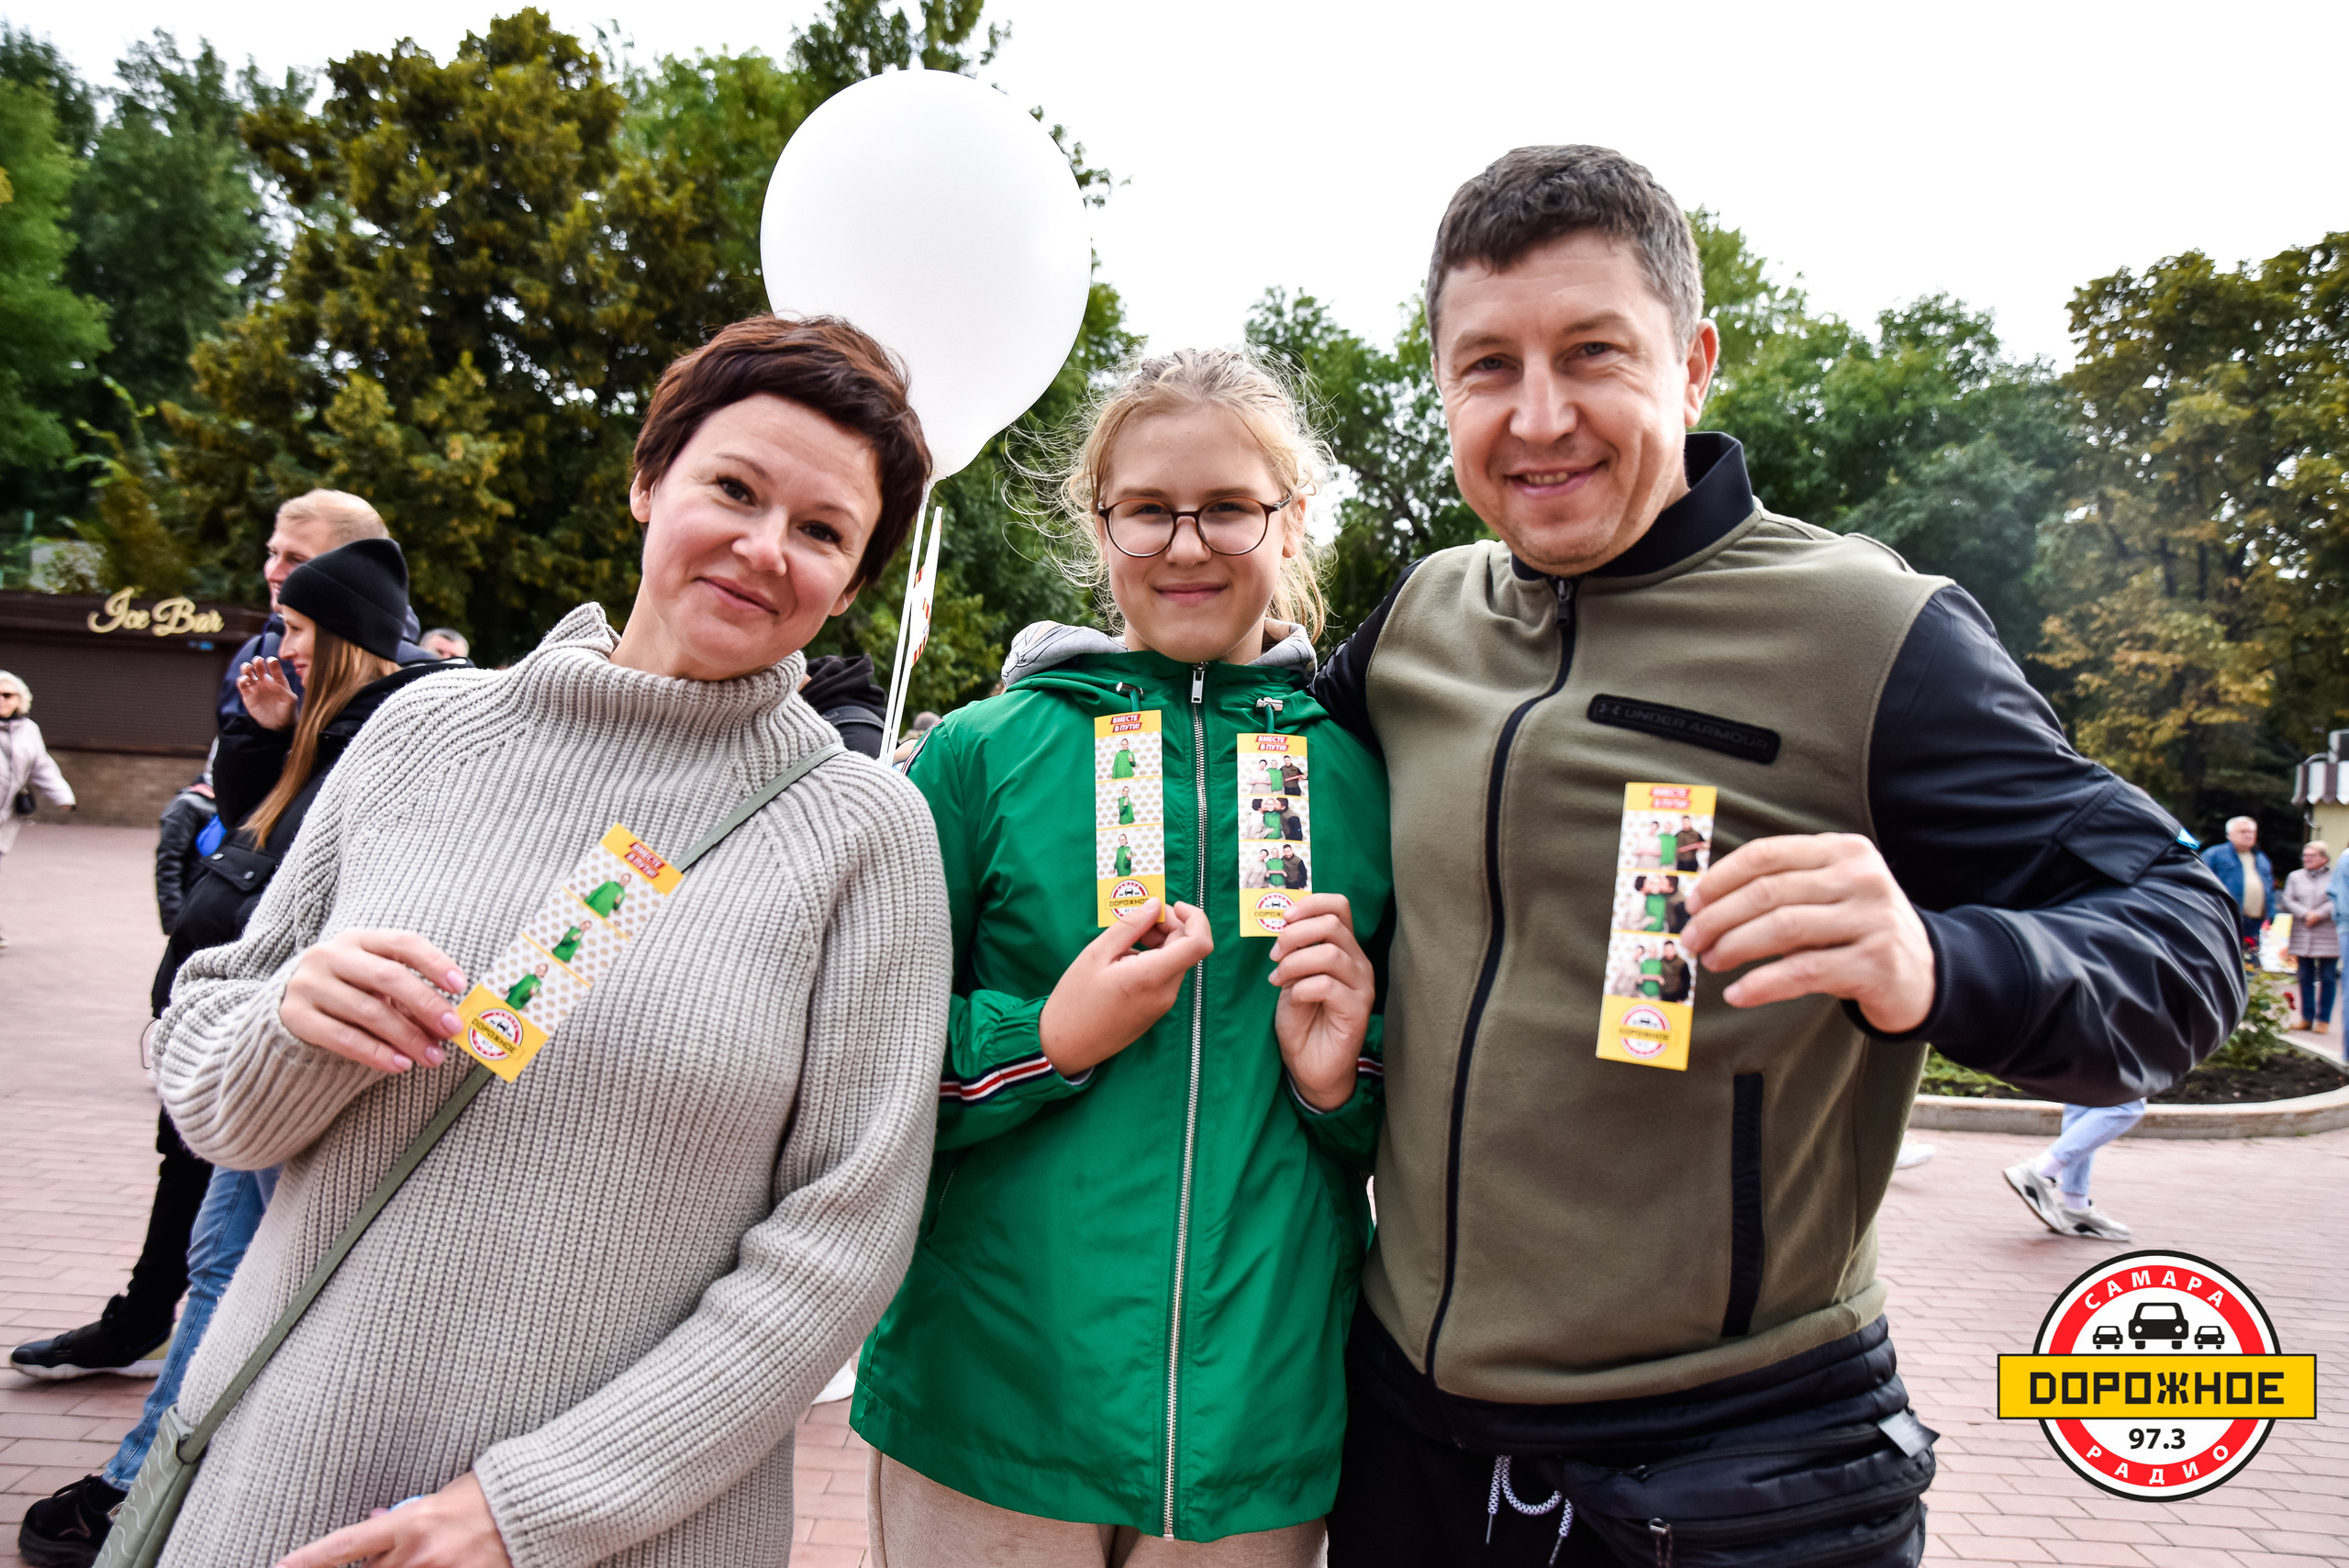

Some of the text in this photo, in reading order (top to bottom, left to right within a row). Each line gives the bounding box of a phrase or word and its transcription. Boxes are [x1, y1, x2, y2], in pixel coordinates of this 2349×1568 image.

[87, 585, 225, 637] Ice Bar
[1111, 715, 1139, 724] ВМЕСТЕ
[1624, 707, 1768, 749] UNDER ARMOUR
